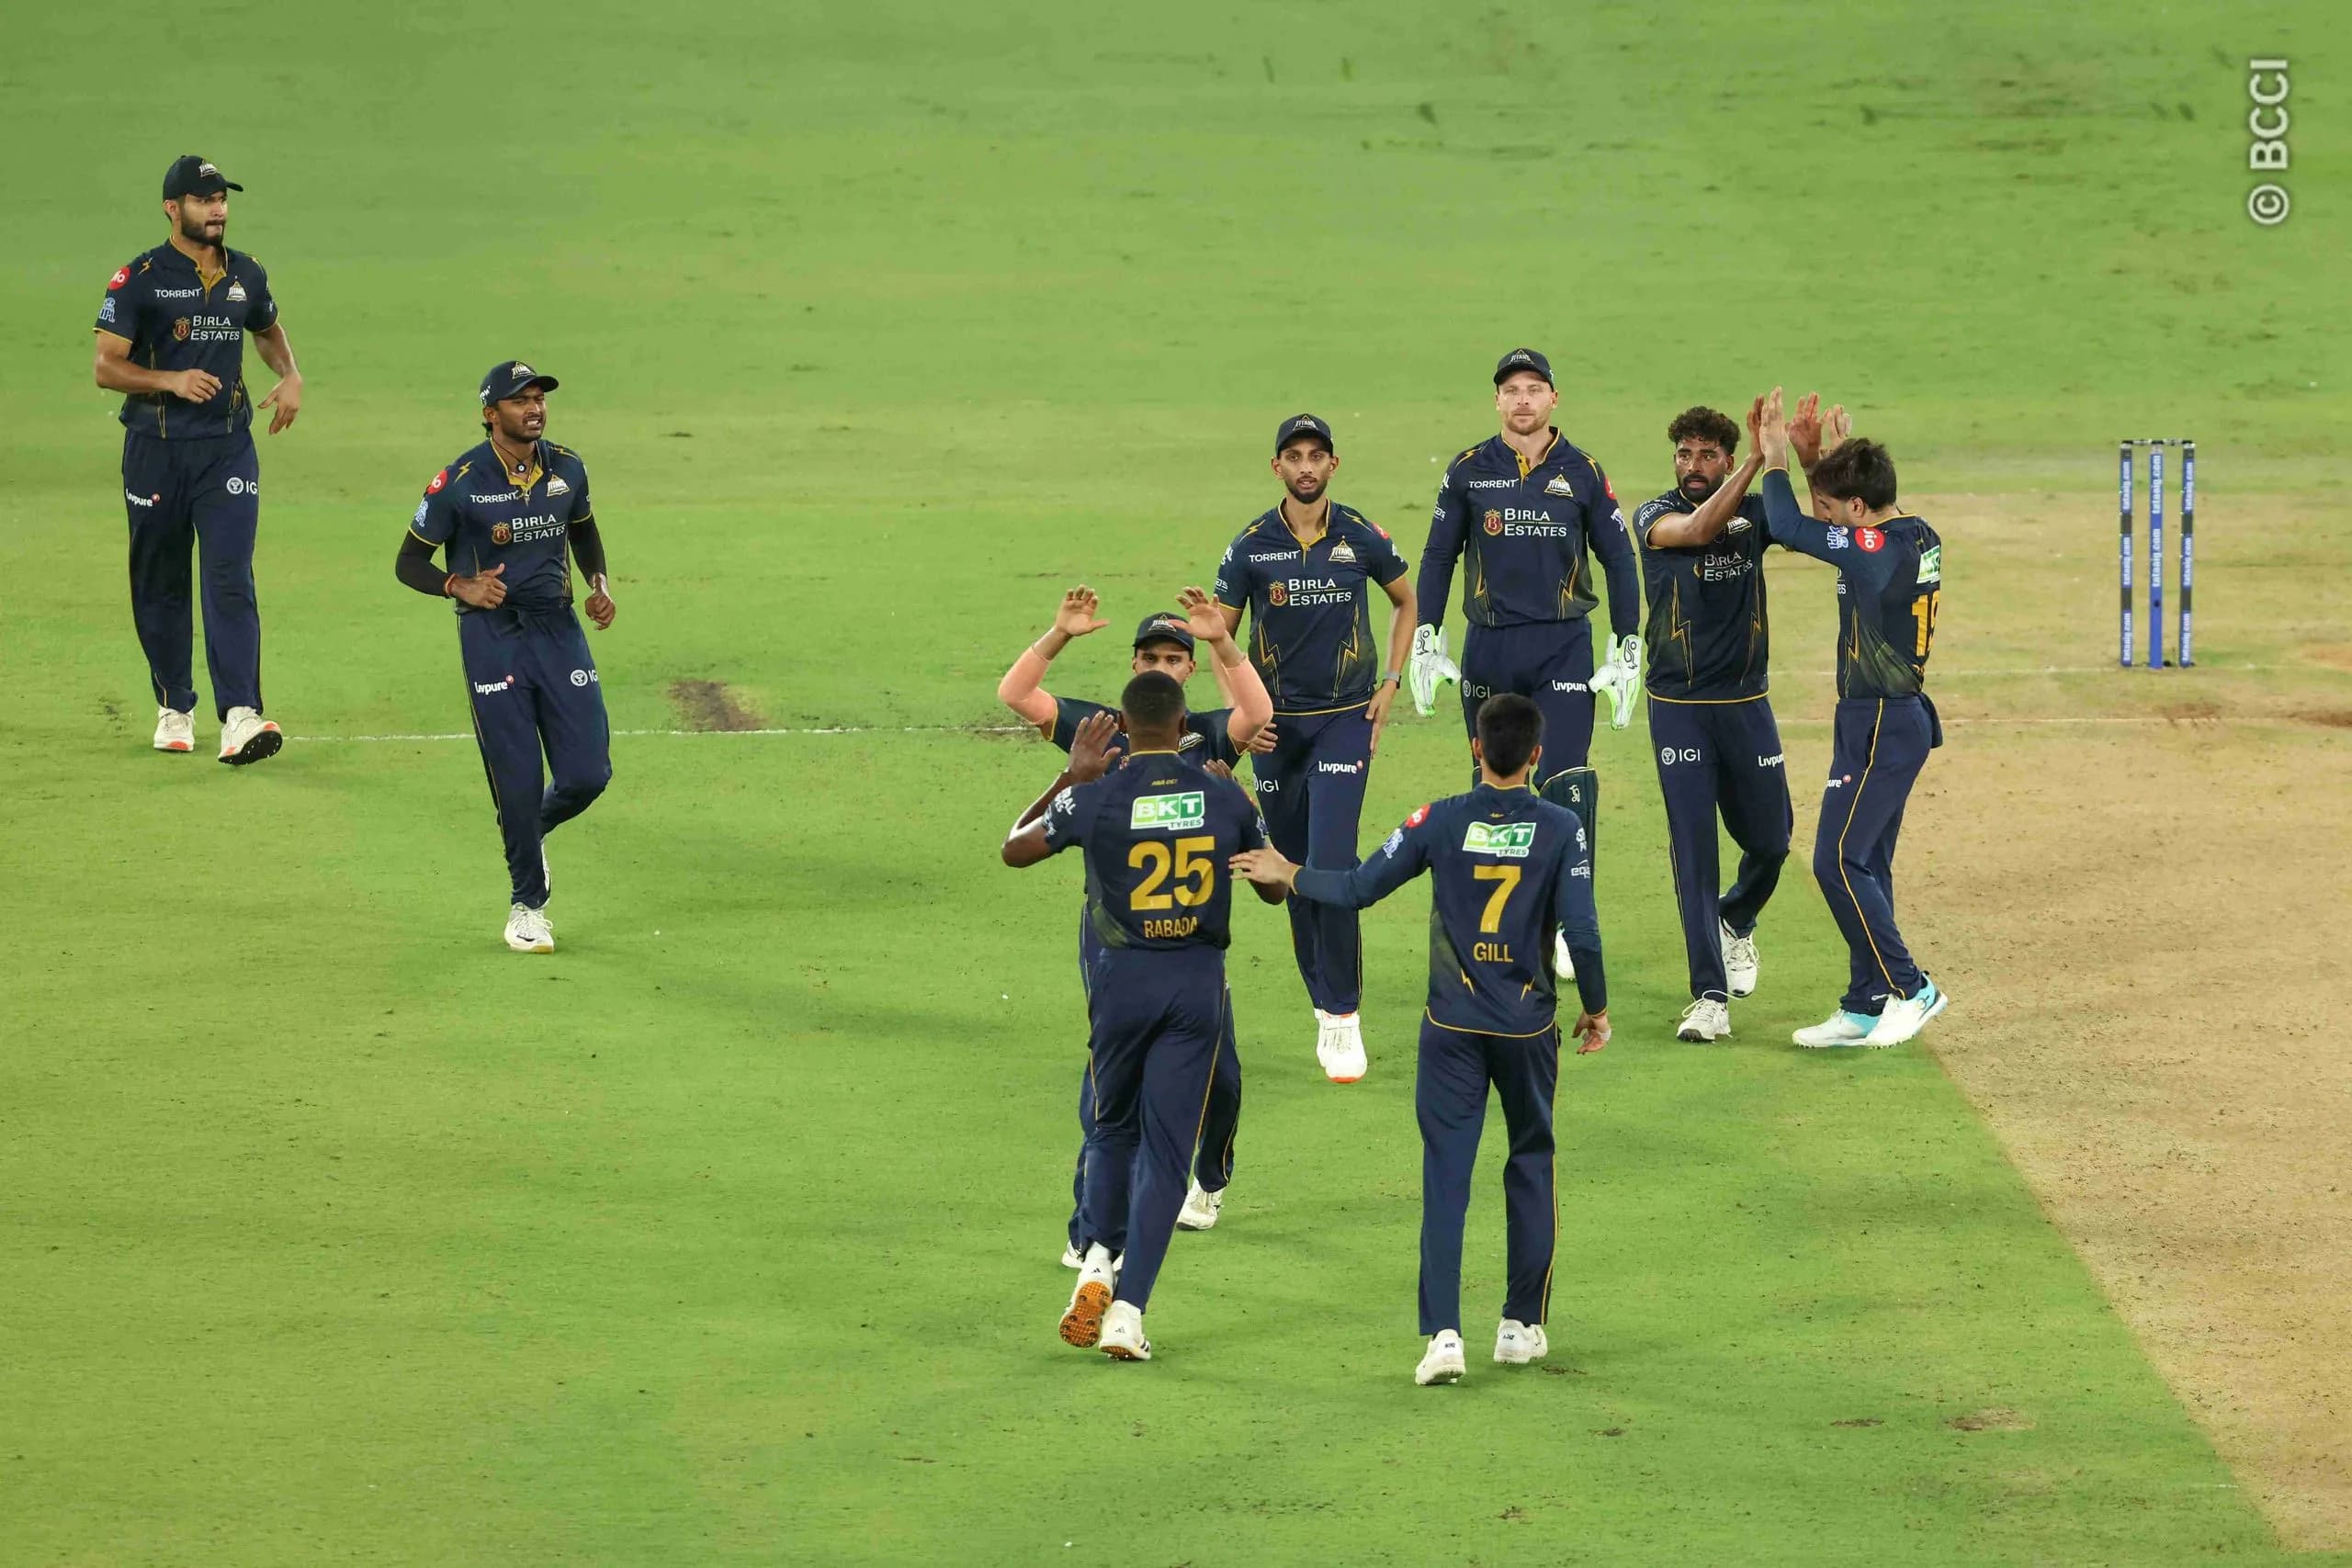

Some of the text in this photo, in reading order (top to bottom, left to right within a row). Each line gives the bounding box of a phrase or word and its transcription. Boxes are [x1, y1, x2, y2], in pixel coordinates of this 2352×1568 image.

[154, 288, 202, 299] TORRENT
[193, 315, 232, 326] BIRLA
[190, 329, 240, 341] ESTATES
[246, 481, 258, 494] IG
[1468, 478, 1520, 489] TORRENT
[469, 490, 518, 504] TORRENT
[512, 514, 557, 530] BIRLA
[1504, 508, 1551, 522] BIRLA
[1504, 524, 1567, 537] ESTATES
[1862, 527, 1877, 549] Jio
[1249, 549, 1300, 563] TORRENT
[1704, 551, 1742, 567] BIRLA
[1288, 578, 1337, 592] BIRLA
[1289, 592, 1352, 606] ESTATES
[588, 670, 598, 682] IG
[1679, 749, 1701, 762] IGI
[1318, 761, 1358, 774] Livpure
[1259, 779, 1280, 793] IGI
[1136, 797, 1201, 818] BKT
[1170, 819, 1202, 829] TYRES
[1470, 827, 1532, 844] BKT
[1128, 835, 1215, 910] 25
[1474, 864, 1521, 933] 7
[1473, 942, 1514, 963] GILL
